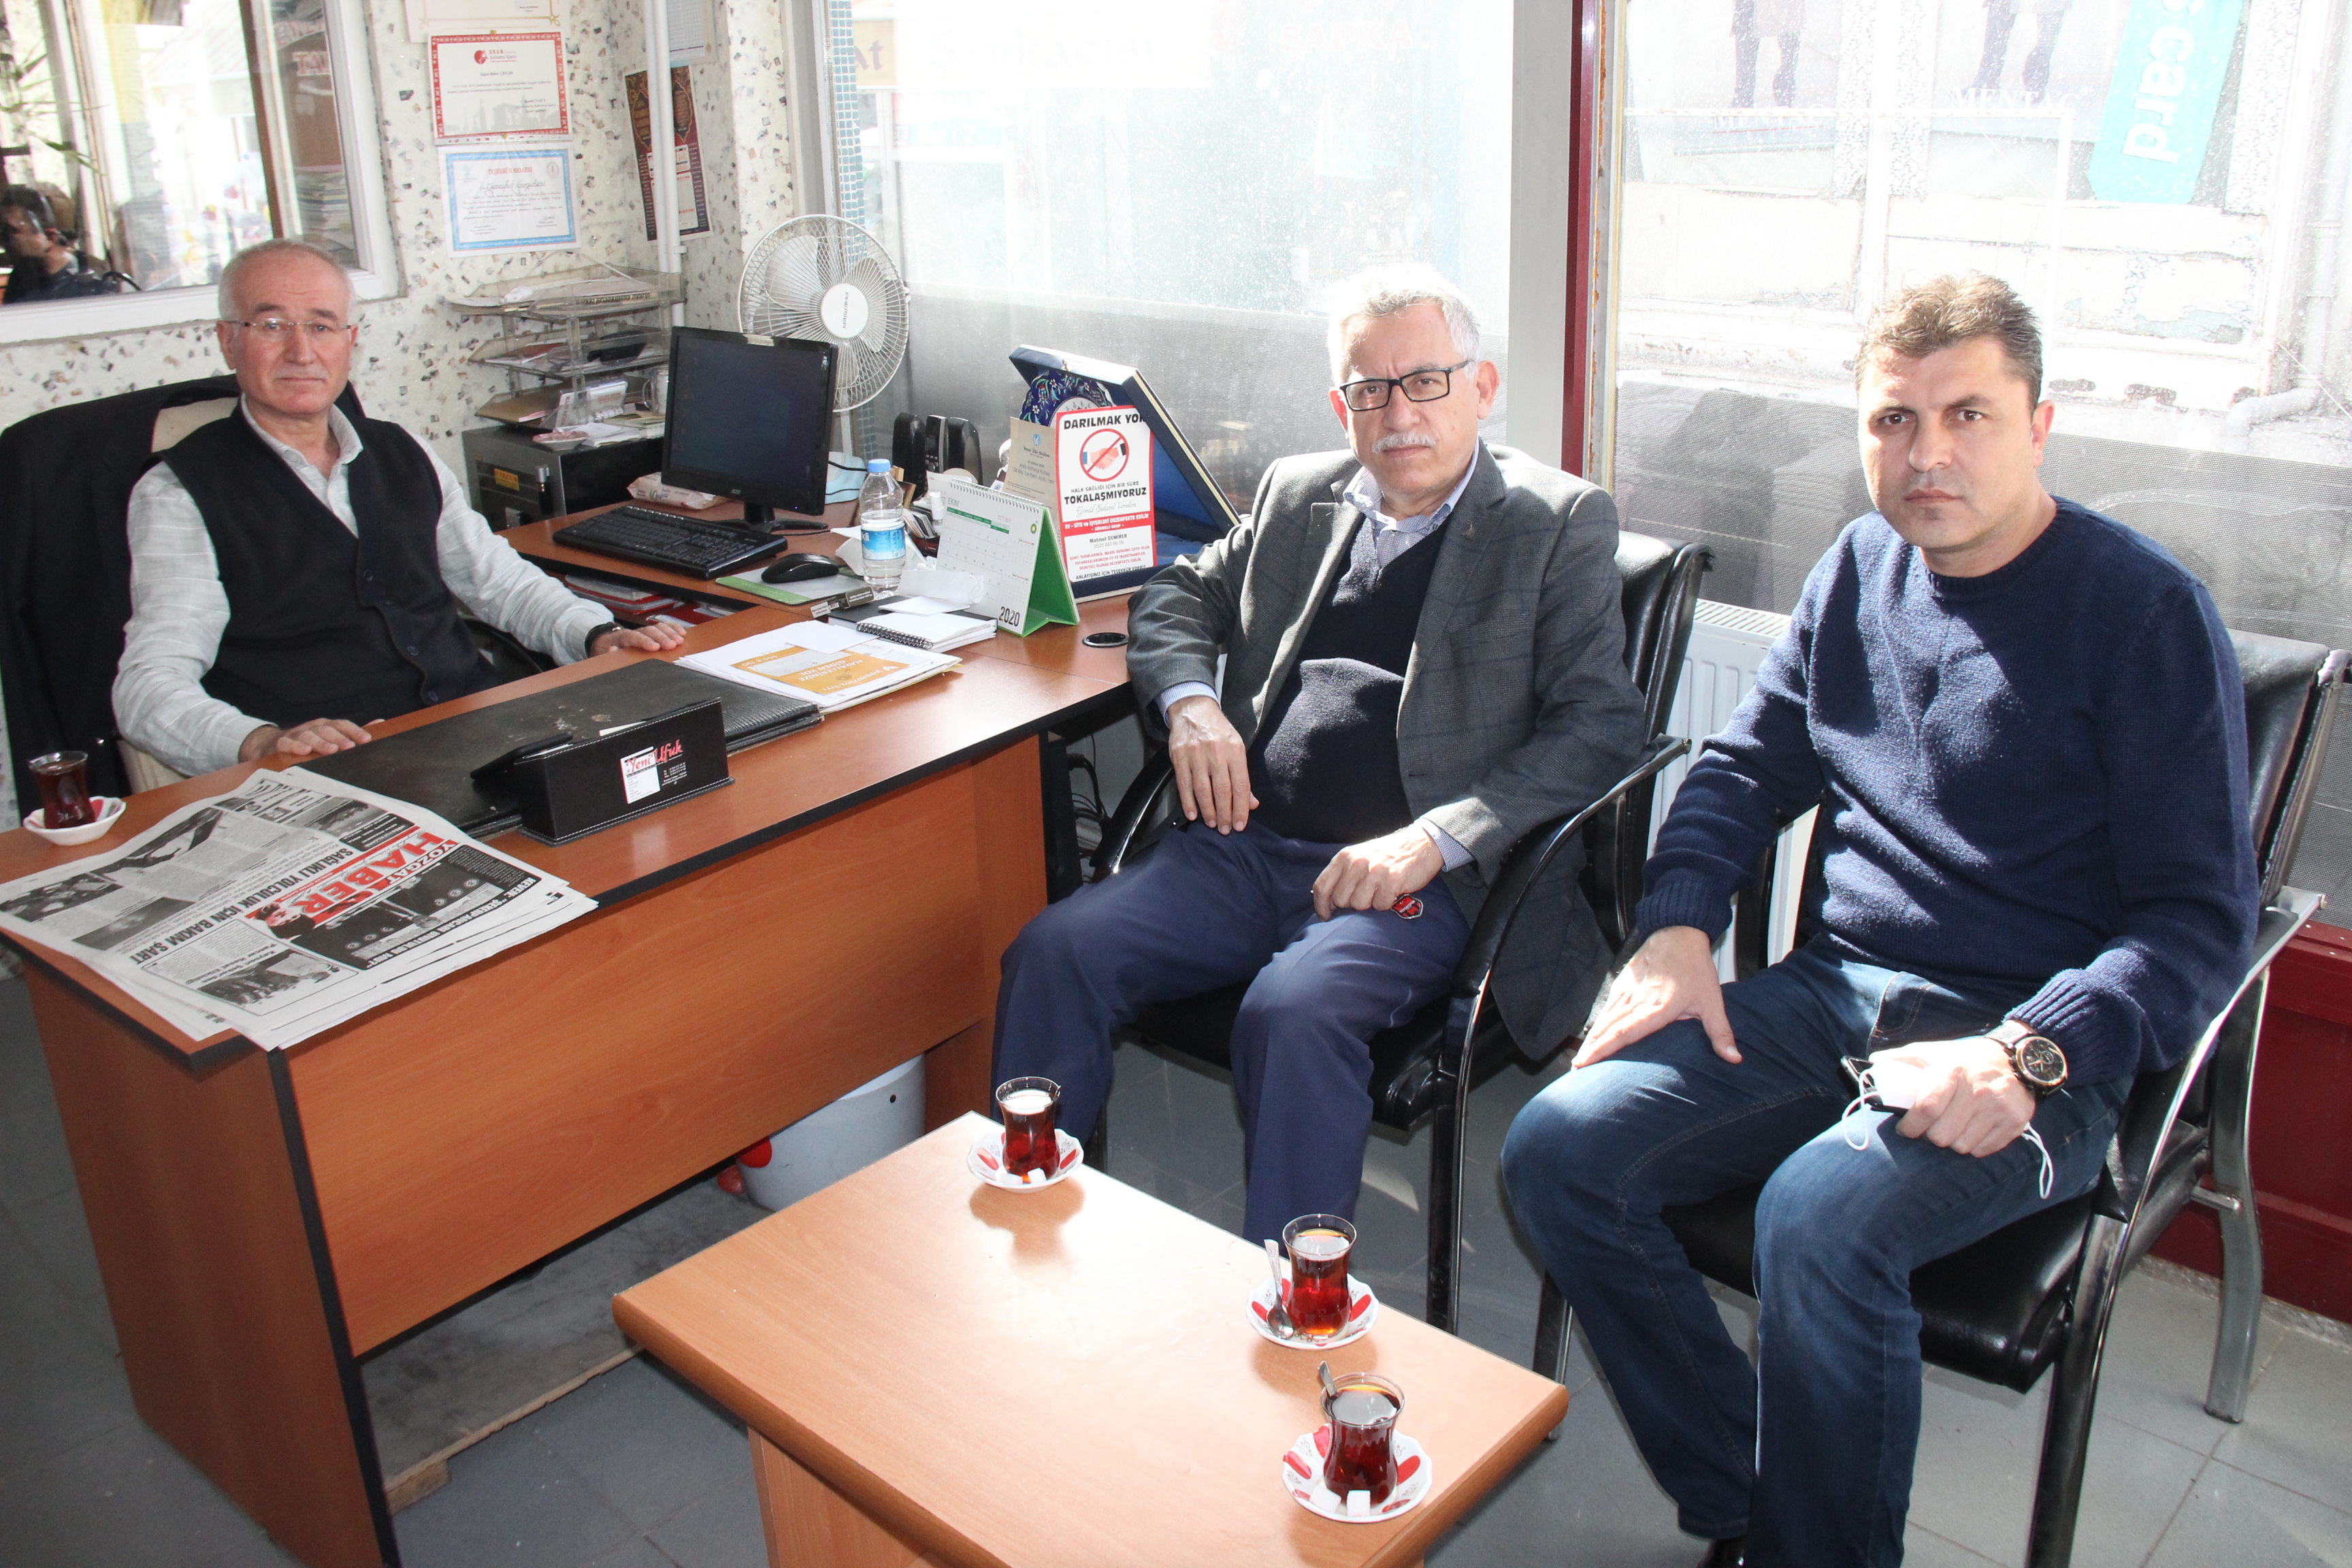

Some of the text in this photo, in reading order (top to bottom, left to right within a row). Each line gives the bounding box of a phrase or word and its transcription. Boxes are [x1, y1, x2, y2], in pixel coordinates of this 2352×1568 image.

[1279, 19, 1414, 61] ŞAPKA
[2121, 26, 2194, 163] card
[1064, 414, 1122, 429] DARILMAK
[948, 497, 960, 506] EKİM
[1064, 487, 1147, 504] TOKALAŞMIYORUZ
[997, 514, 1012, 523] OCTOBER
[1076, 504, 1094, 518] Gönül
[1089, 517, 1109, 527] İŞYERLERİ
[1110, 514, 1135, 523] DEZENFEKTE
[998, 606, 1020, 627] 2020
[797, 659, 863, 682] HAYALLERİNİZE
[798, 659, 847, 676] GİDEN YOL
[626, 739, 683, 772] Yeni Ufuk
[289, 832, 444, 913] HABER
[298, 848, 354, 882] SAĞLIKLI
[387, 840, 457, 884] YOZGAT
[237, 874, 301, 911] YOLCULUK
[502, 877, 537, 900] KEVEN:
[210, 904, 240, 923] İÇİN
[164, 919, 213, 946] BAKIM
[391, 928, 440, 955] UNUTULDU
[129, 942, 169, 965] ŞART
